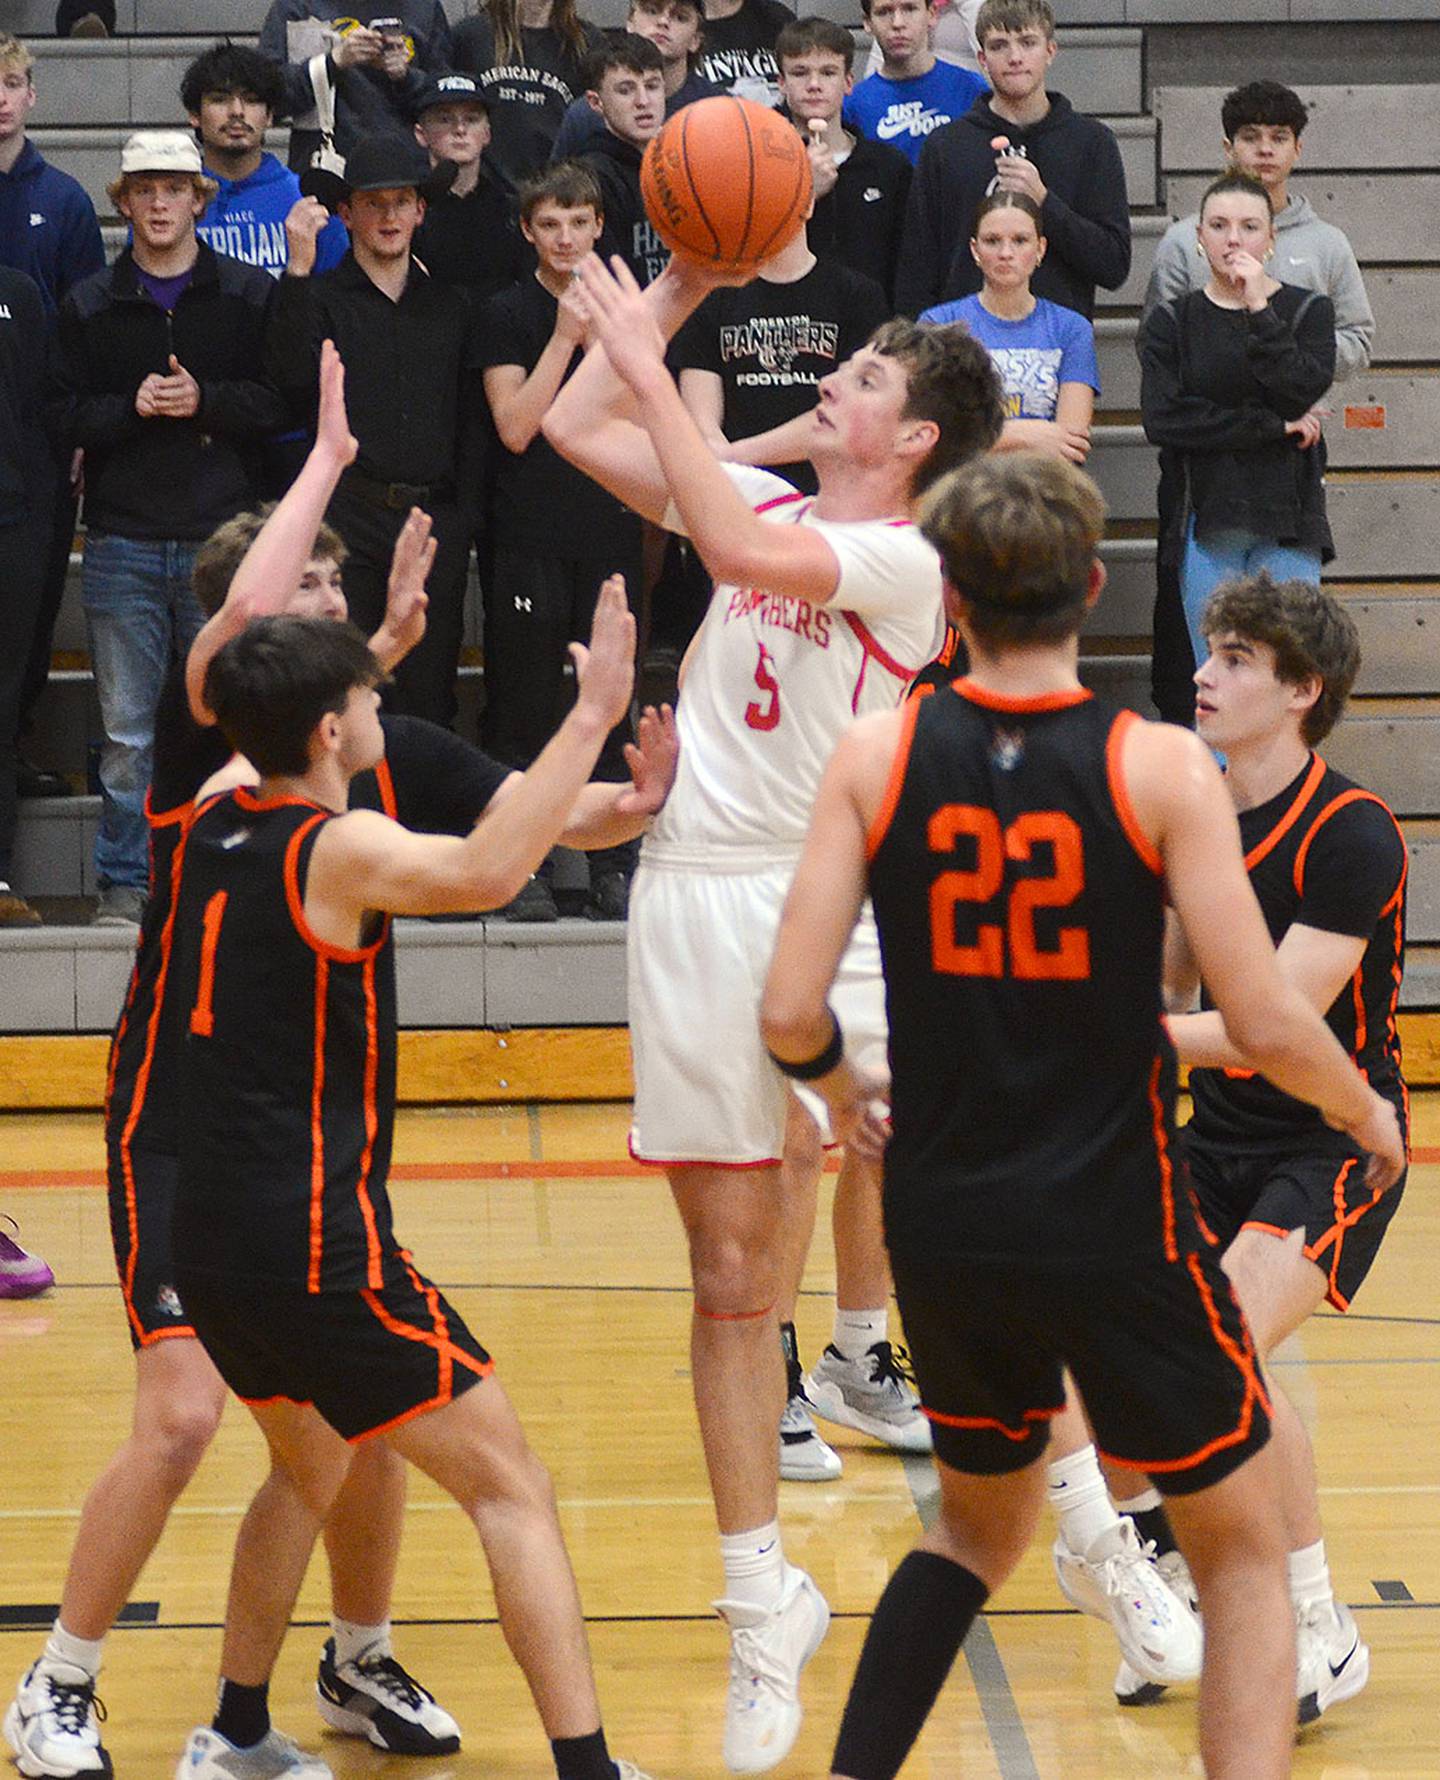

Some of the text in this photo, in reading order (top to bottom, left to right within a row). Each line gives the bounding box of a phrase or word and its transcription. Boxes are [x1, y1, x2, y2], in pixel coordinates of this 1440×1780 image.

[480, 66, 540, 88] MERICAN
[884, 101, 923, 124] JUST
[720, 319, 839, 362] PANTHERS
[736, 371, 820, 386] FOOTBALL
[744, 639, 781, 732] 5
[927, 802, 1092, 981] 22
[189, 888, 229, 1038] 1
